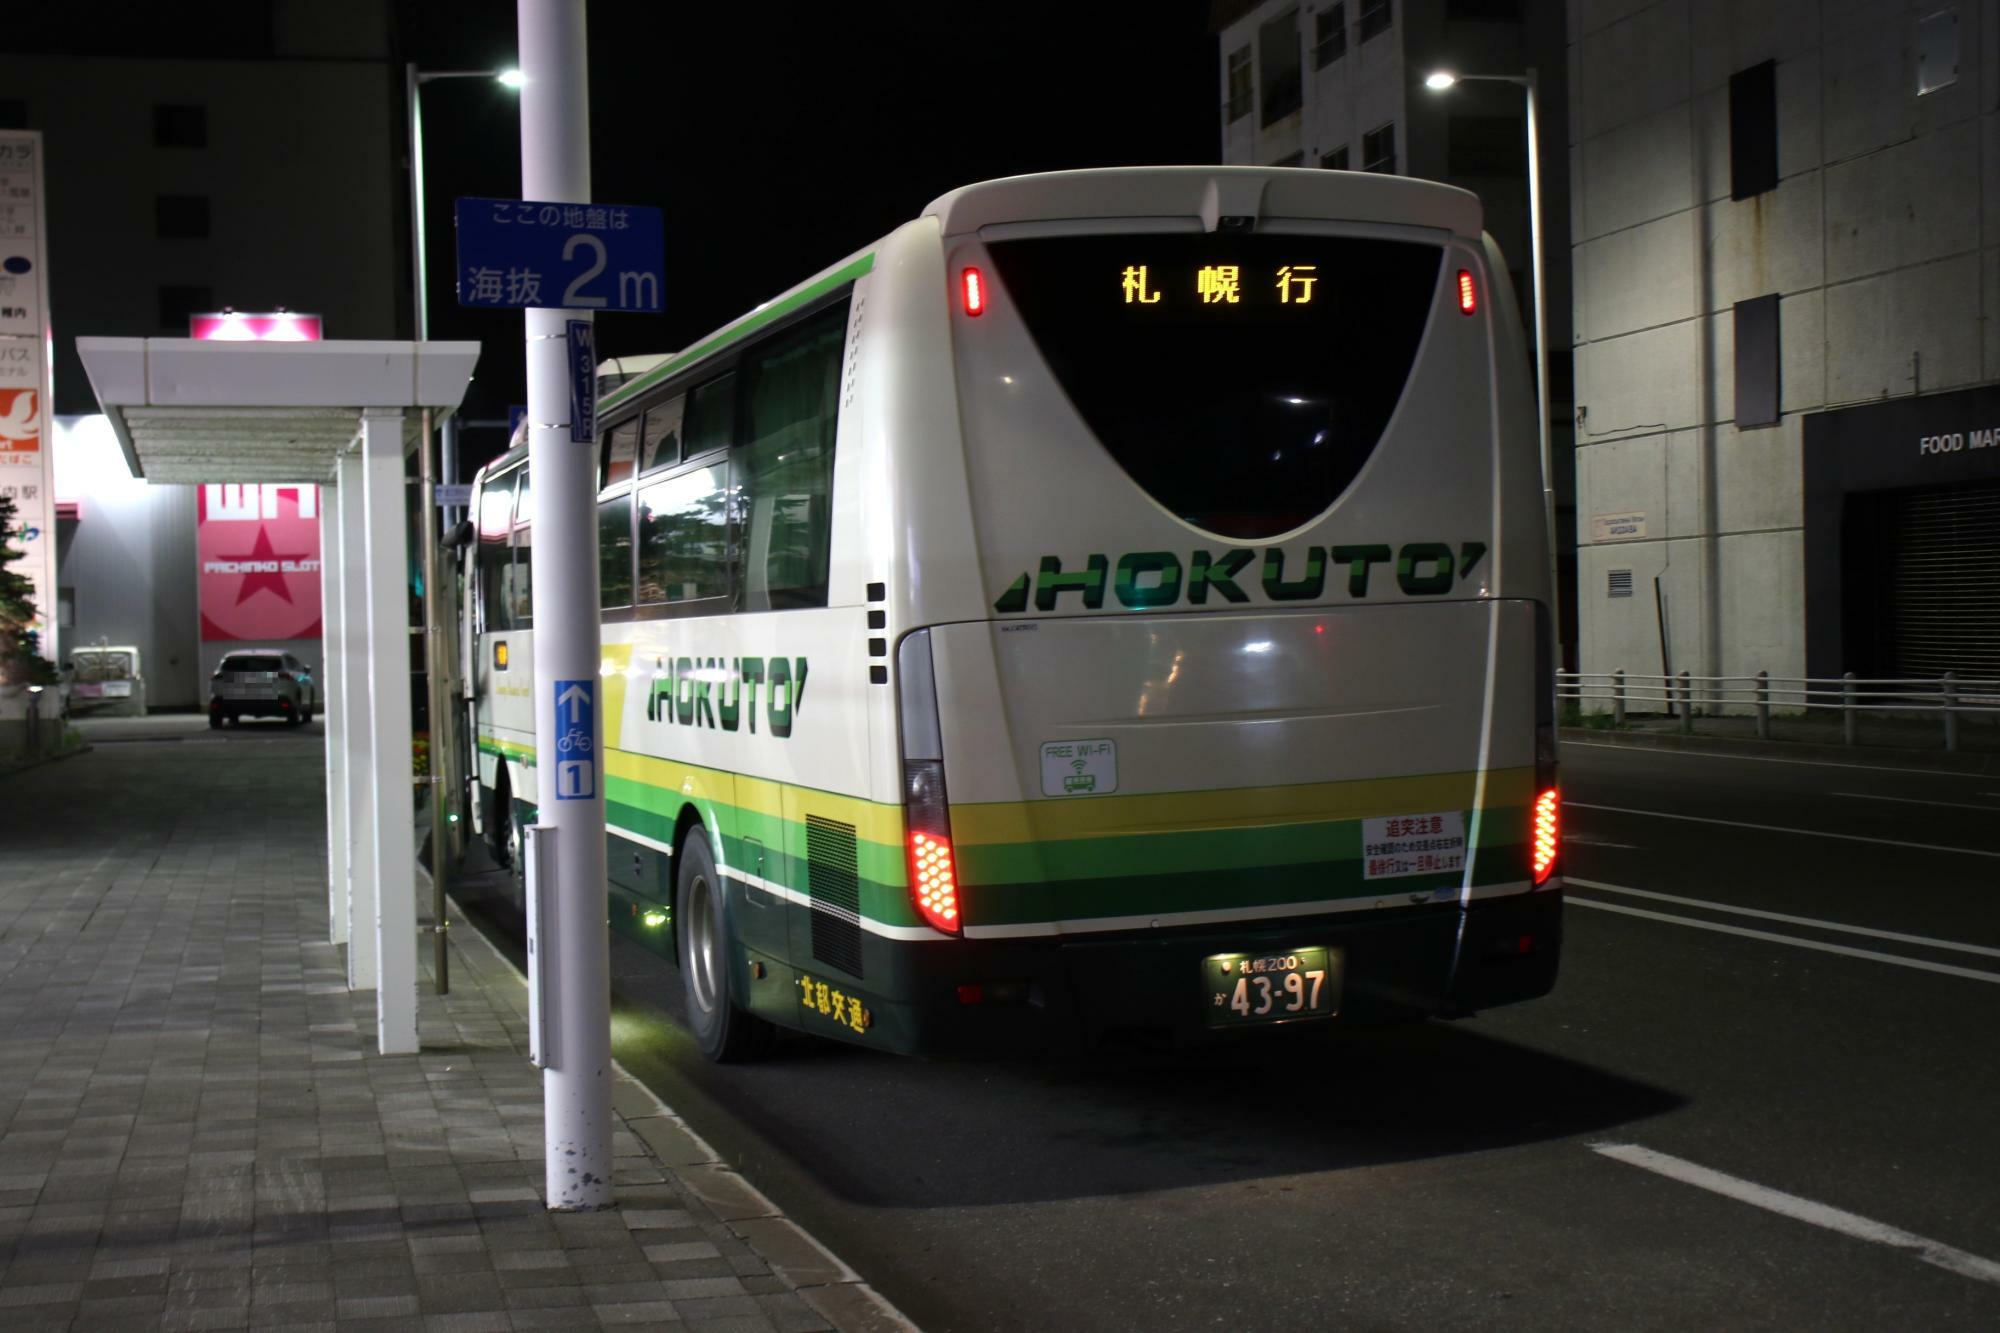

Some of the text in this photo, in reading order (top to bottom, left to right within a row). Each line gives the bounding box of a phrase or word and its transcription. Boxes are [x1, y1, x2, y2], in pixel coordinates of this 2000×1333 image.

[493, 203, 629, 230] ここの地盤は
[468, 267, 542, 304] 海抜
[1122, 265, 1318, 303] 札幌行
[1920, 433, 1964, 455] FOOD
[204, 560, 320, 574] PACHINKO SLOT
[1035, 541, 1455, 612] HOKUTO
[656, 657, 793, 739] HOKUTO
[1046, 745, 1073, 758] FREE
[567, 764, 580, 795] 1
[1386, 816, 1444, 838] 追突注意
[800, 974, 865, 1034] 北都交通
[1230, 969, 1325, 1017] 43-97
